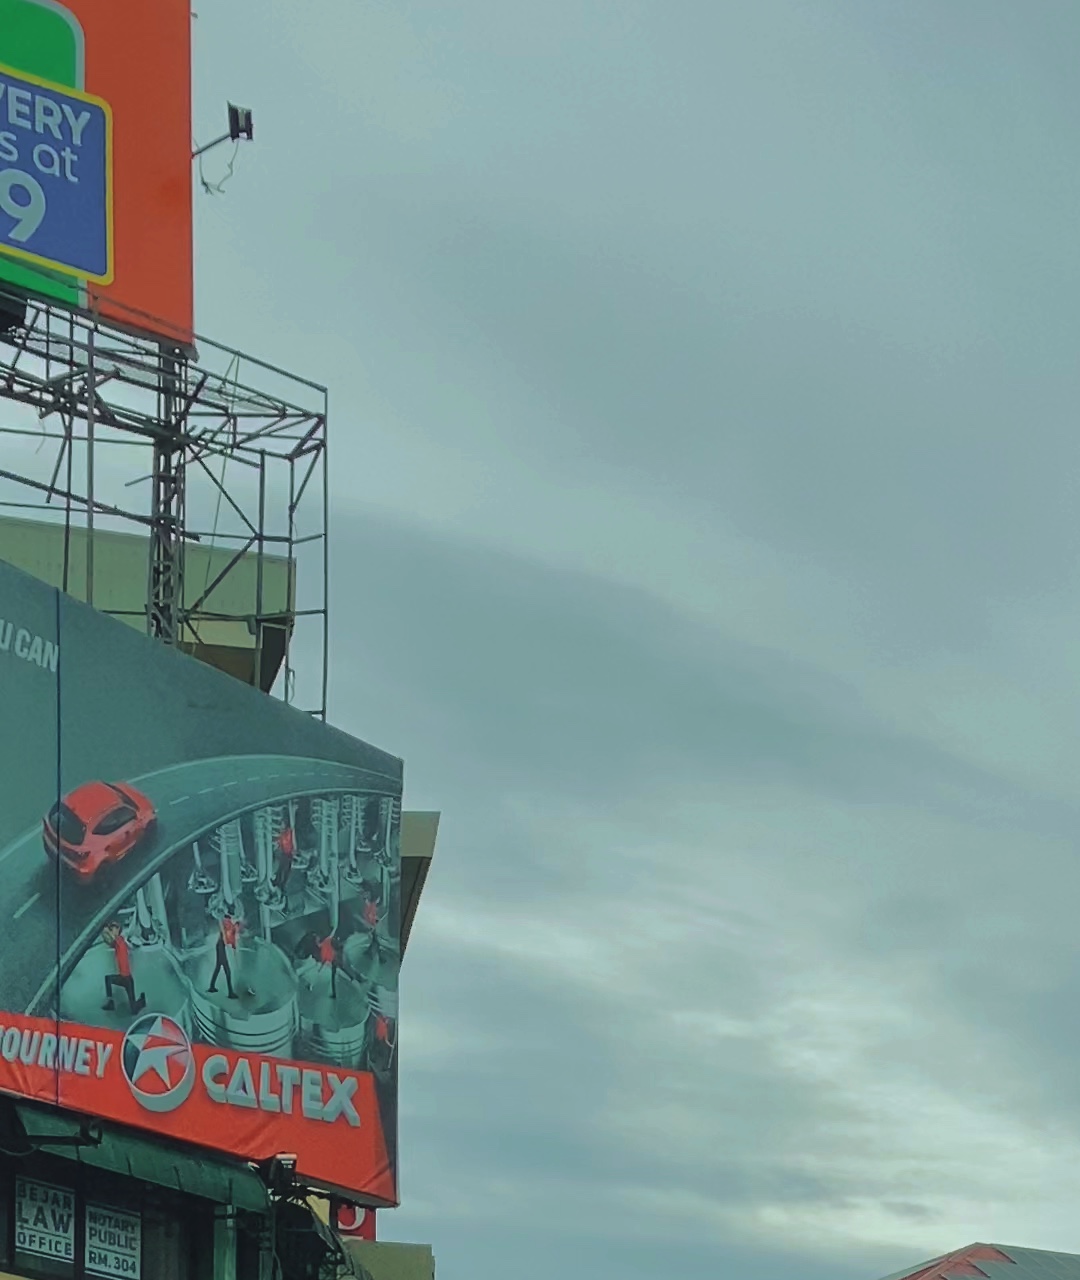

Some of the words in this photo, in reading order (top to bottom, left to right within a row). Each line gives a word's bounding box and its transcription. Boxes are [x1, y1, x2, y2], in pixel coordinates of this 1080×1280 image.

[0, 82, 91, 147] ERY
[32, 143, 79, 183] at
[14, 628, 60, 673] CAN
[202, 1053, 361, 1127] CALTEX
[16, 1182, 73, 1211] BEJAR
[16, 1201, 73, 1234] LAW
[88, 1210, 137, 1235] NOTARY
[17, 1231, 73, 1257] OFFICE
[88, 1227, 137, 1252] PUBLIC
